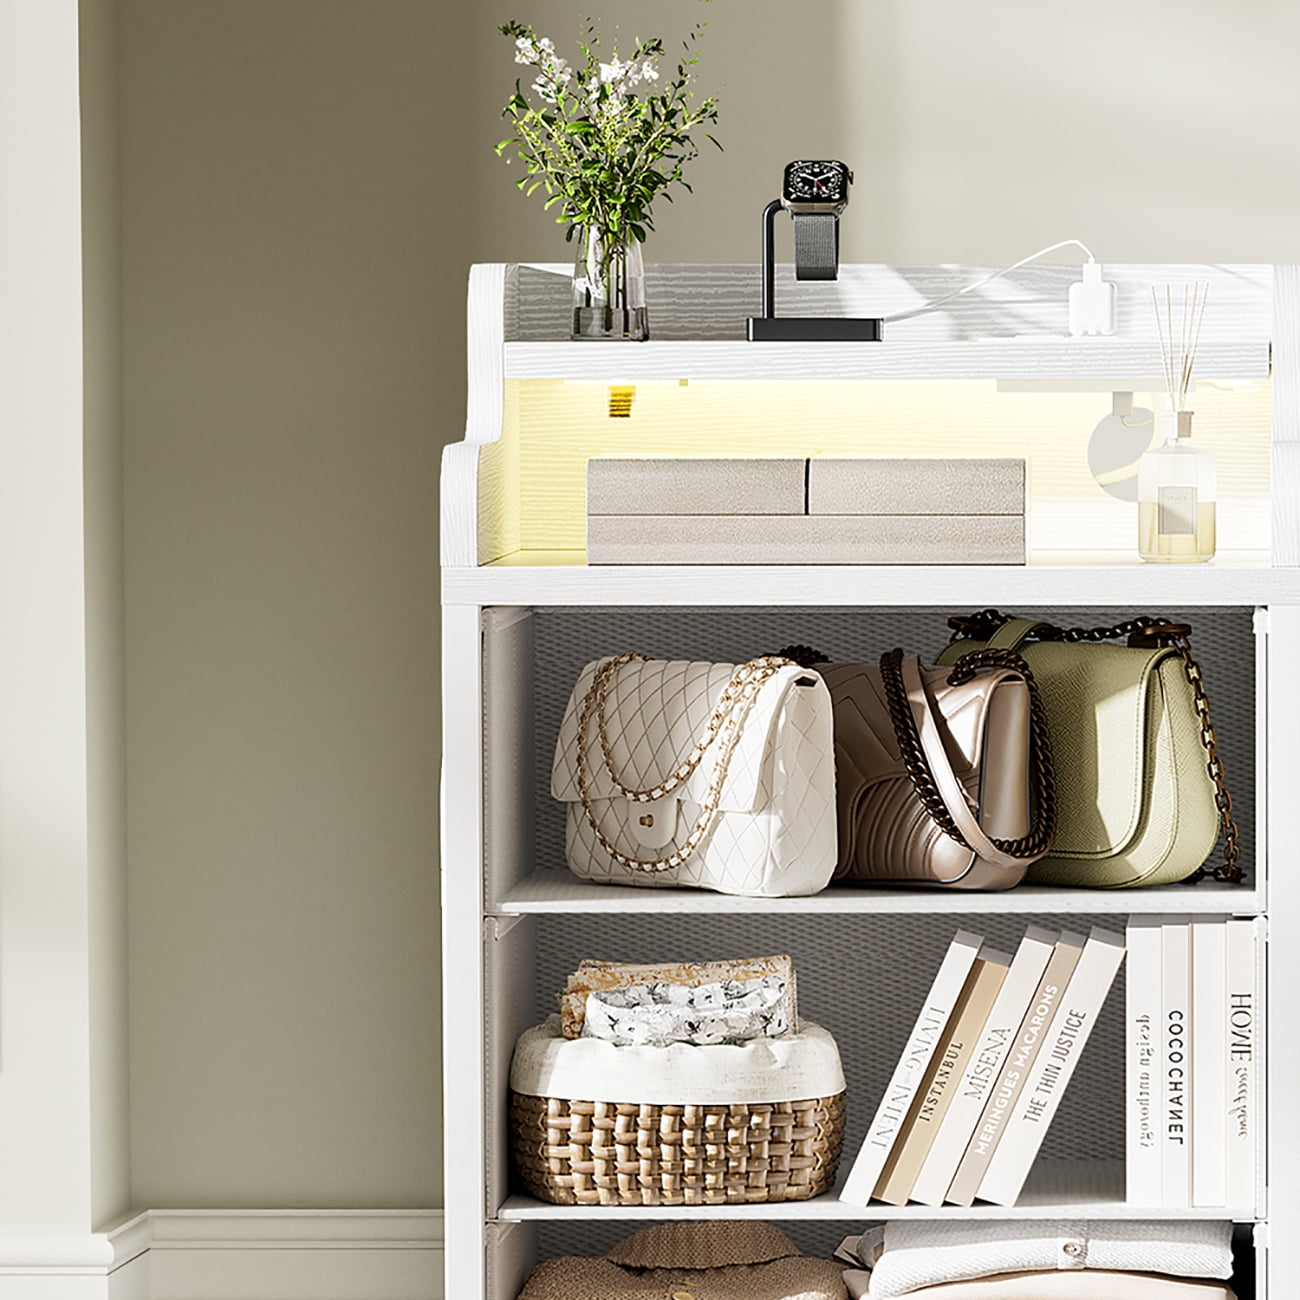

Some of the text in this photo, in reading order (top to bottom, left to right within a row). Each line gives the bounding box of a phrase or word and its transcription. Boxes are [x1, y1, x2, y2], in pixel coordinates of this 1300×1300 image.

[919, 1042, 964, 1122] INSTANBUL
[974, 984, 1059, 1156] MERINGUES MACARONS
[1023, 1008, 1087, 1123] THE THIN JUSTICE
